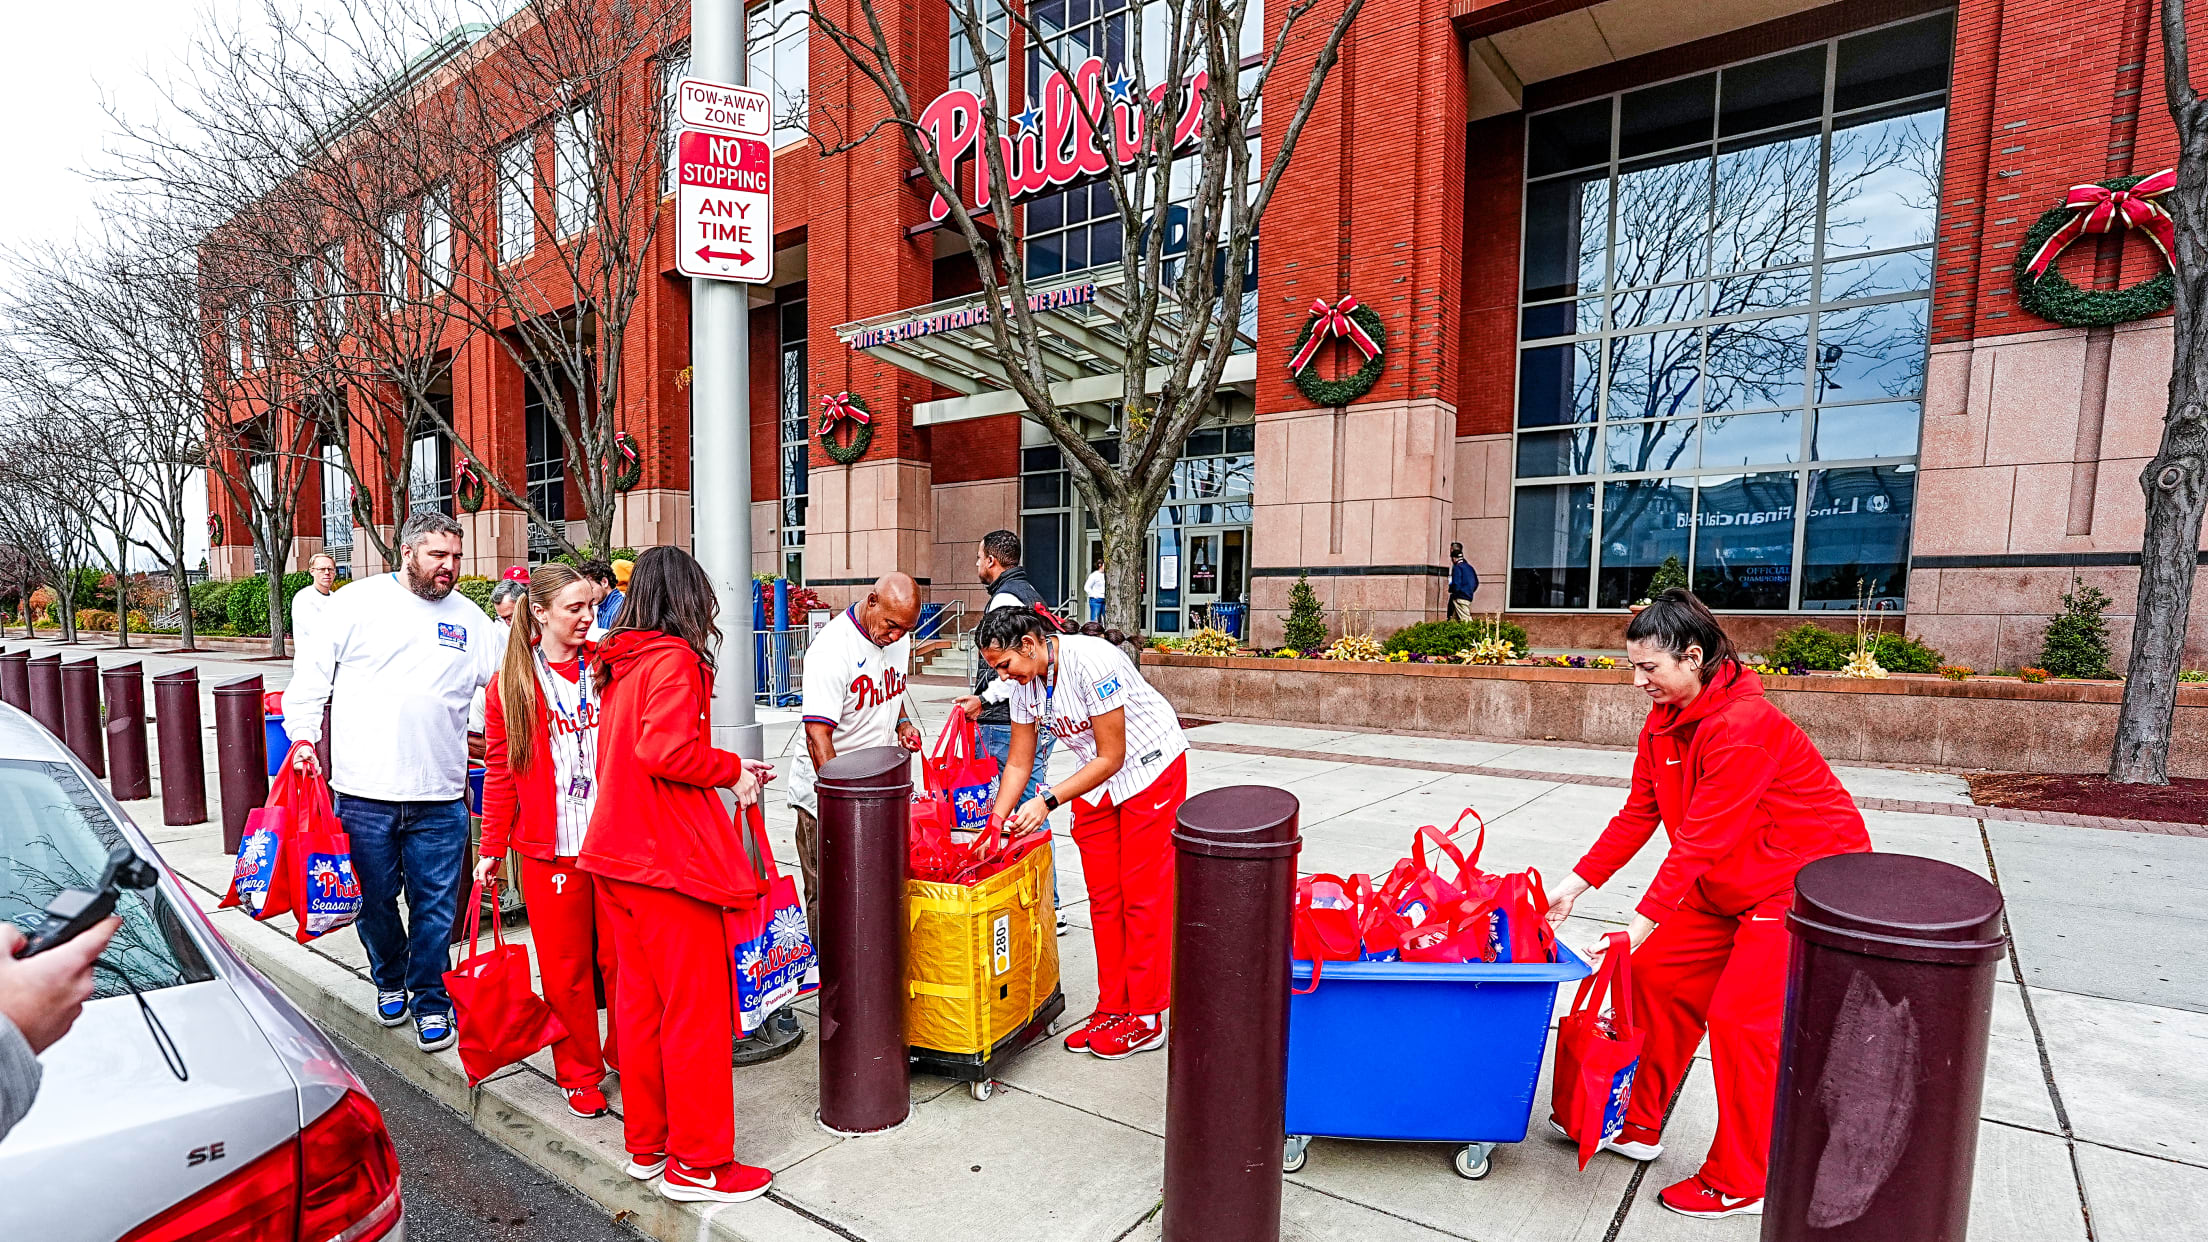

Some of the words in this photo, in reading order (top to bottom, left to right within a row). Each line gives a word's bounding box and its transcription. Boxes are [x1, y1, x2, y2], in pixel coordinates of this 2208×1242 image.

[685, 86, 765, 113] TOW-AWAY
[704, 107, 746, 127] ZONE
[709, 136, 741, 167] NO
[683, 162, 767, 191] STOPPING
[699, 198, 751, 220] ANY
[697, 221, 752, 243] TIME
[850, 330, 881, 350] SUITE
[884, 328, 894, 343] &
[896, 320, 927, 341] CLUB
[928, 306, 990, 334] ENTRANCE
[1009, 294, 1047, 317] HME
[1050, 284, 1093, 310] PLATE
[850, 666, 907, 711] Phillie
[1096, 676, 1122, 700] IBX
[551, 873, 567, 895] P
[312, 898, 351, 911] Season
[996, 926, 1007, 956] 280
[774, 969, 786, 989] of
[186, 1141, 226, 1167] SE
